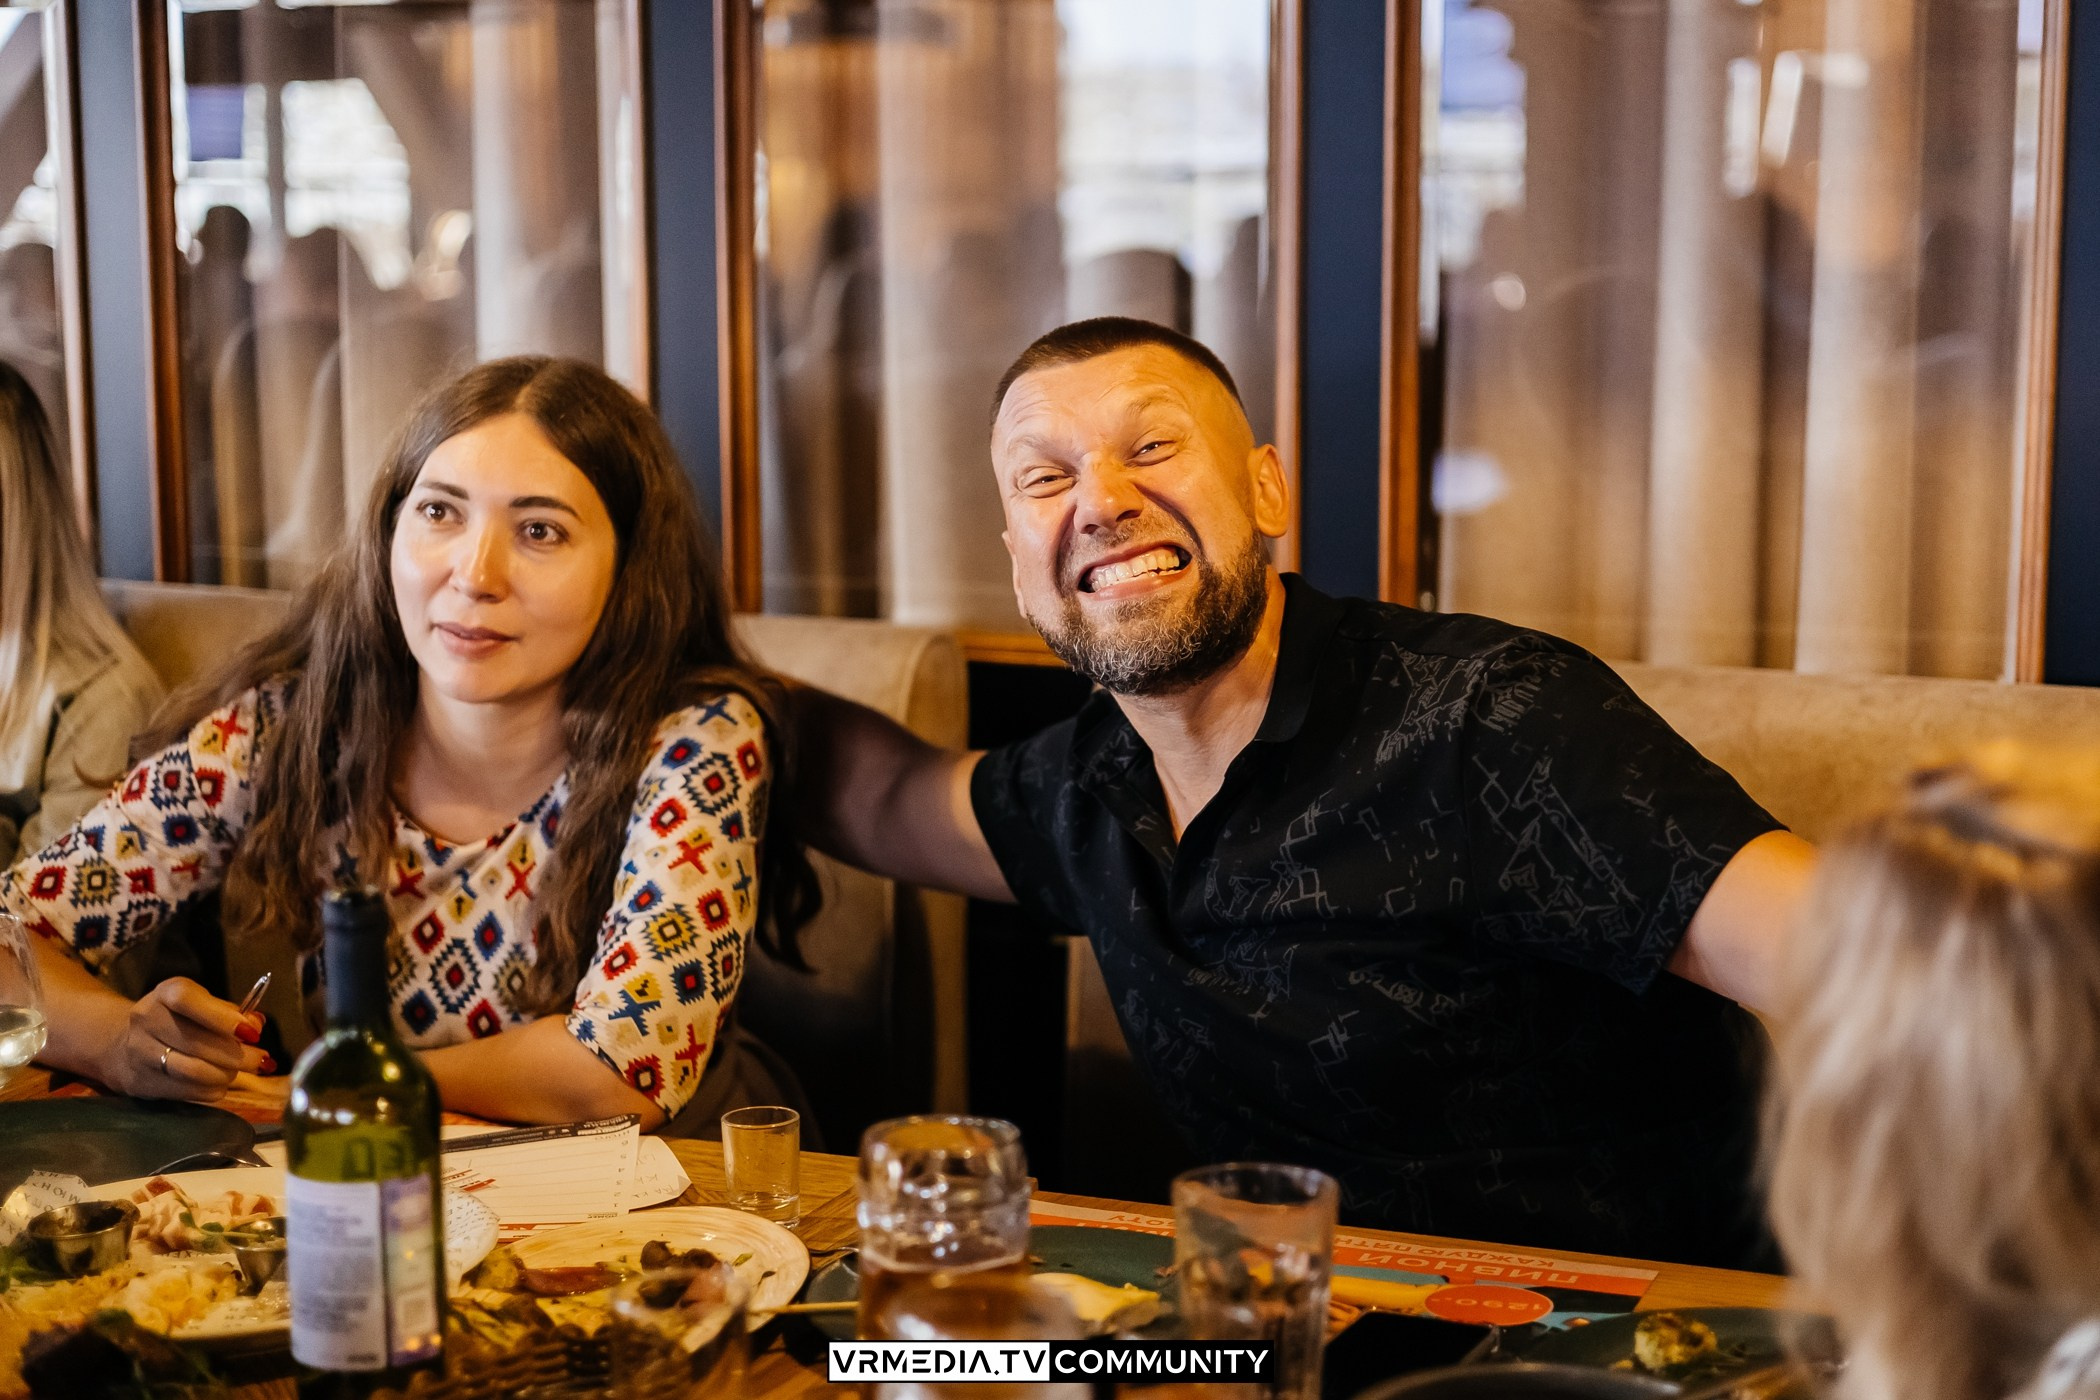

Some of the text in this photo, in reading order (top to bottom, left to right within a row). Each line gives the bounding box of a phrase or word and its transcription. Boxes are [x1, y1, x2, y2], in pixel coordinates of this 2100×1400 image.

[1333, 1237, 1411, 1252] ПЯТН
[1416, 1248, 1554, 1268] КАЖДУЮ
[1358, 1253, 1579, 1284] ПИВНОЙ
